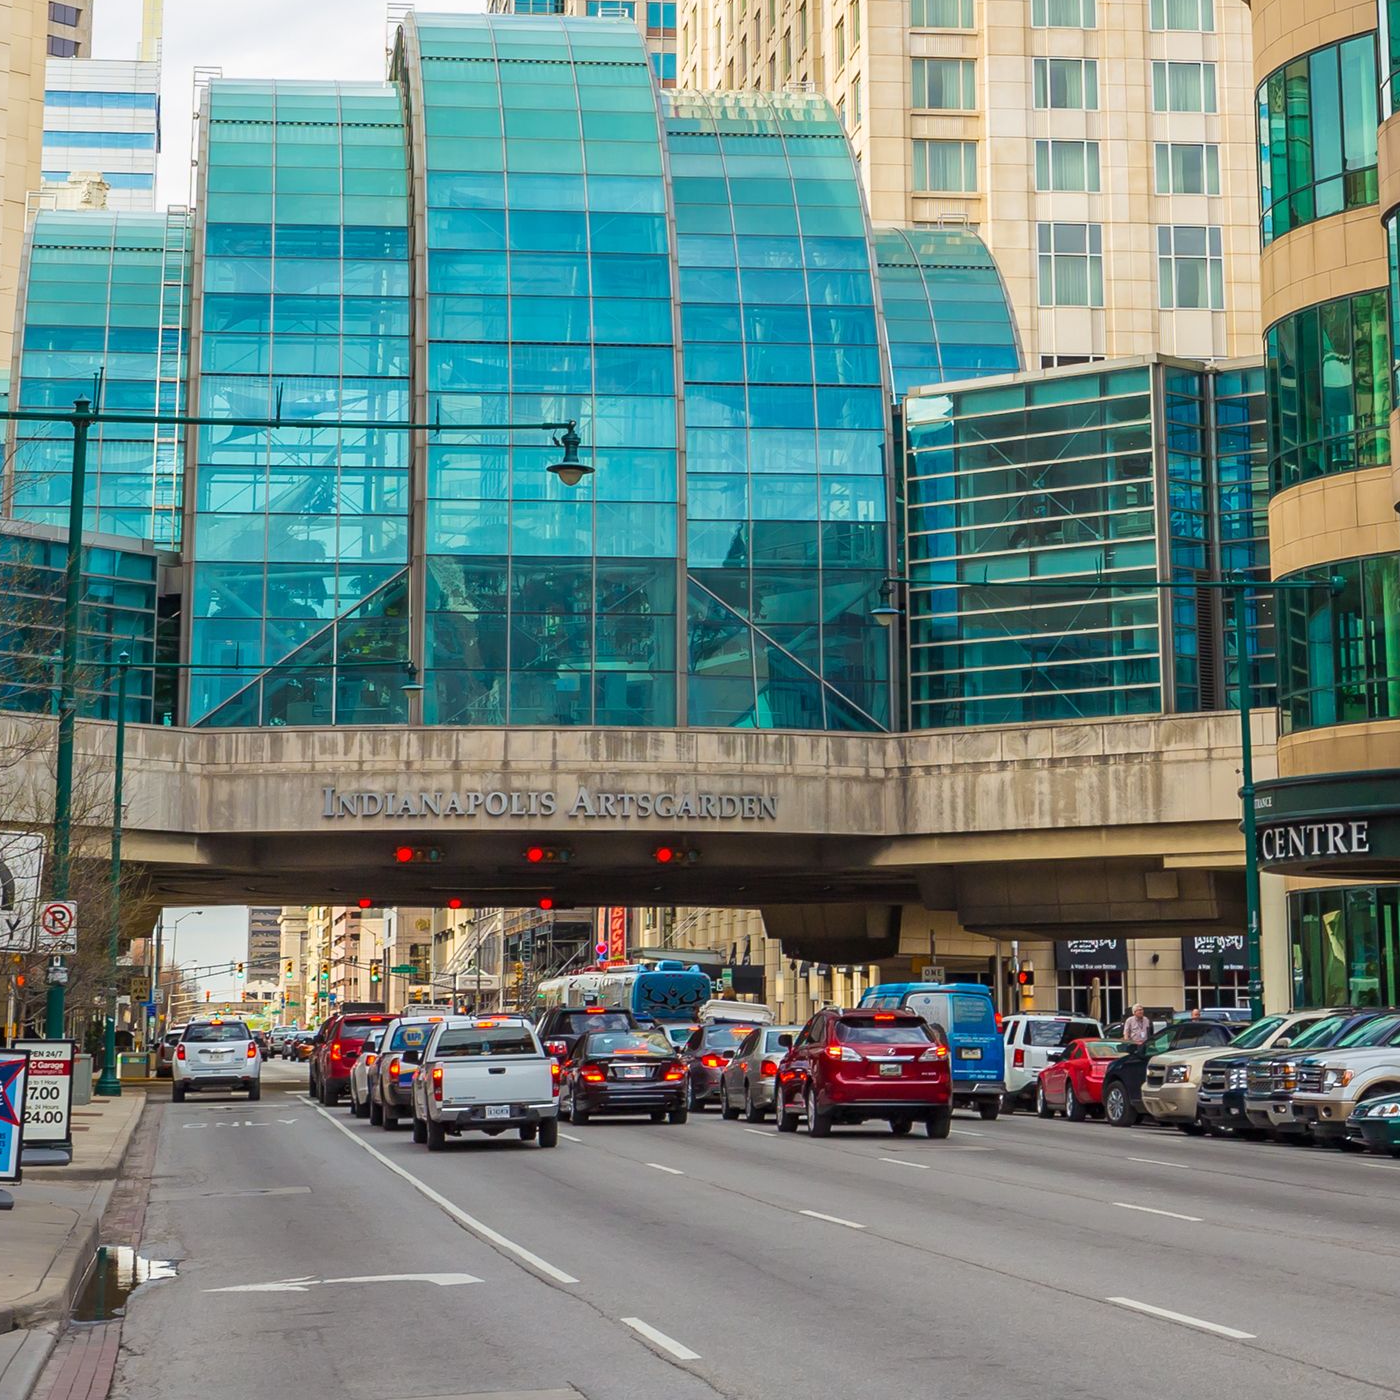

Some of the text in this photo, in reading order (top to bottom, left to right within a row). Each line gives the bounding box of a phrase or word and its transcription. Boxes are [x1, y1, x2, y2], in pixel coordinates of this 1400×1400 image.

[322, 785, 779, 820] INDIANAPOLIS ARTSGARDEN
[1262, 821, 1369, 860] CENTRE
[38, 1062, 64, 1070] Garage
[28, 1087, 59, 1100] 7.00
